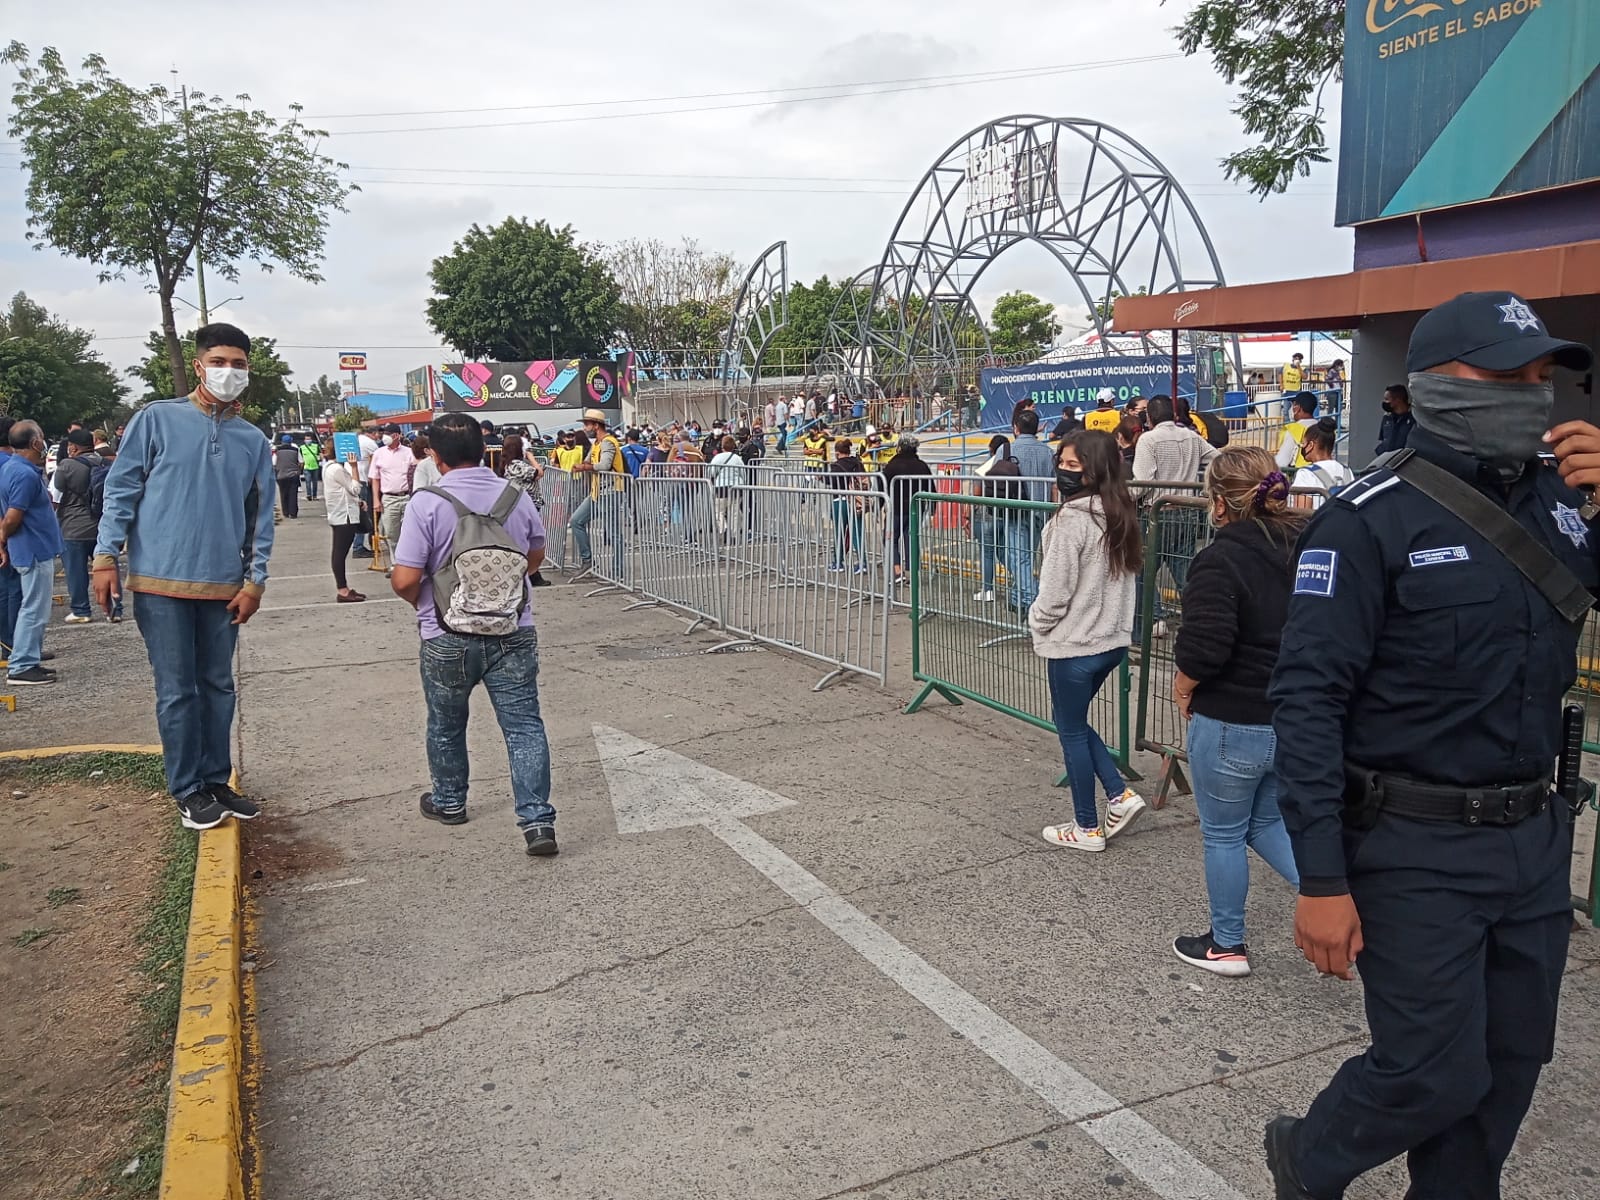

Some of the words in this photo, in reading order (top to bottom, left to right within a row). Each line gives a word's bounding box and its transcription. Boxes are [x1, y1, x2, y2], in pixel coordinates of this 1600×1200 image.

[1378, 26, 1440, 59] SIENTE
[1445, 18, 1467, 40] EL
[1473, 0, 1542, 29] SABOR
[992, 373, 1036, 385] MACROCENTRO
[1036, 367, 1092, 381] METROPOLITANO
[1093, 367, 1102, 376] DE
[1103, 362, 1155, 376] VACUNACIÓN
[490, 391, 531, 400] MEGACABLE
[1031, 386, 1141, 404] BIENVENOS
